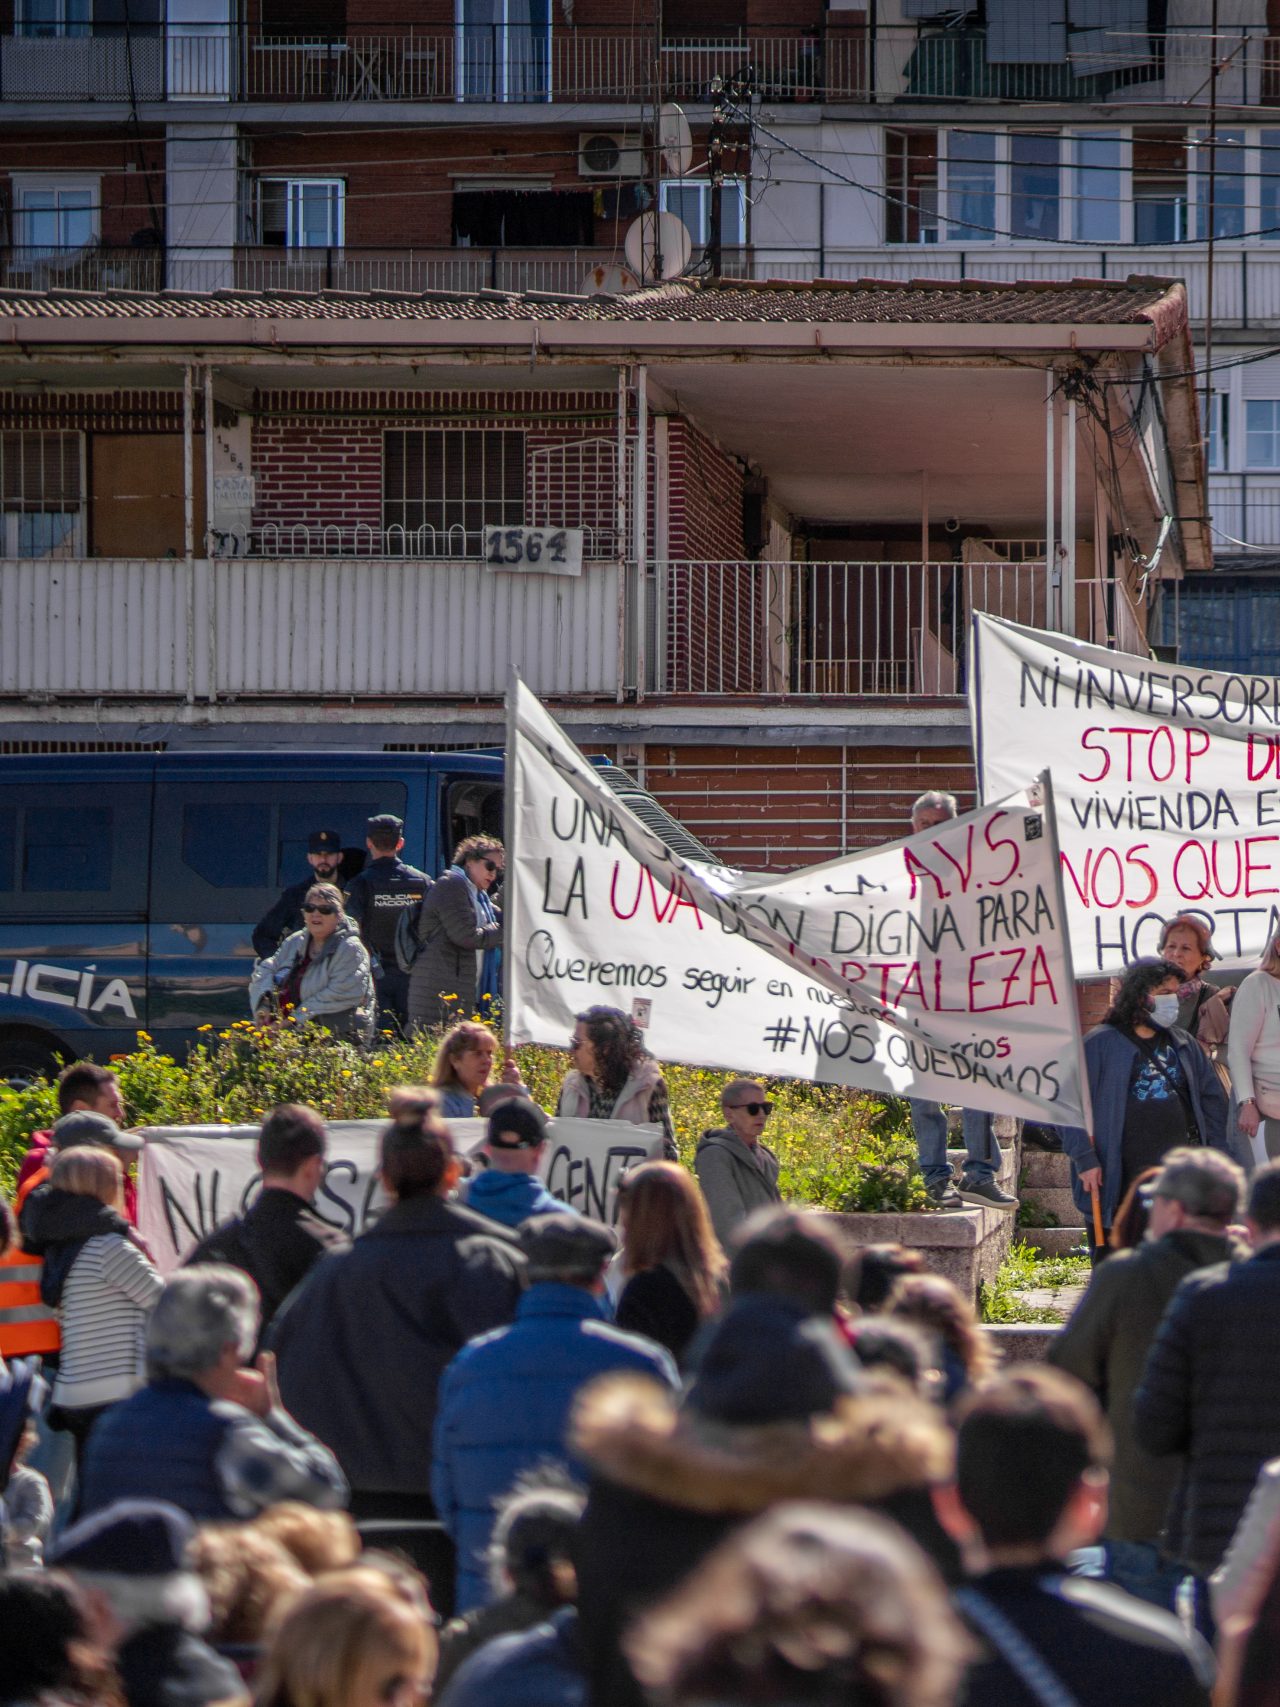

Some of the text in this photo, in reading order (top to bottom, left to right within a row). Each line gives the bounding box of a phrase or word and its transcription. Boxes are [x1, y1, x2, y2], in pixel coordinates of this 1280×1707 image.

[1078, 725, 1211, 784] STOP
[552, 796, 630, 850] UNA
[543, 855, 588, 920] LA
[609, 859, 704, 931] UVA
[1060, 844, 1159, 909] NOS
[975, 884, 1055, 947] PARA
[526, 929, 668, 989] Queremos
[682, 966, 757, 1008] seguir
[767, 978, 794, 998] en
[762, 1014, 877, 1064] #NOS
